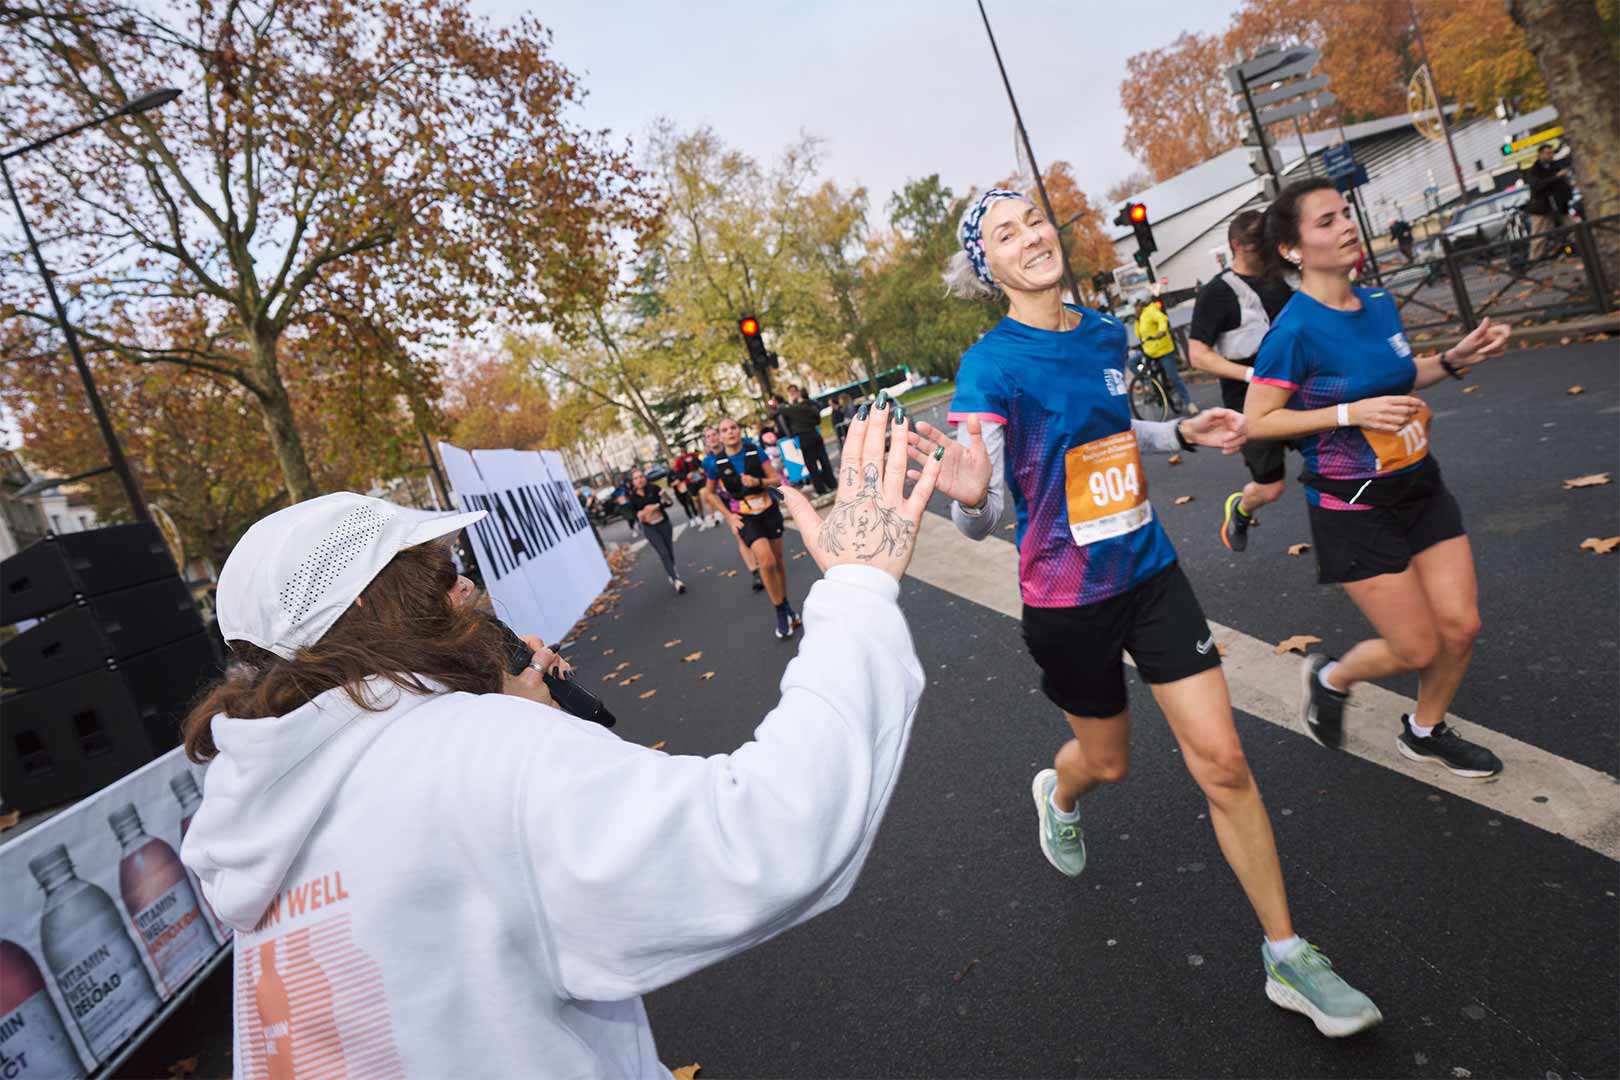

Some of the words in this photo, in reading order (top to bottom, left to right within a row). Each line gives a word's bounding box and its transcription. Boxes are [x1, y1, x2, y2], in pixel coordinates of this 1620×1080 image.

[1089, 463, 1139, 507] 904
[138, 891, 178, 929] VITAMIN
[287, 870, 348, 919] WELL
[62, 944, 111, 991] VITAMIN
[69, 975, 98, 1004] WELL
[74, 973, 121, 1019] RELOAD
